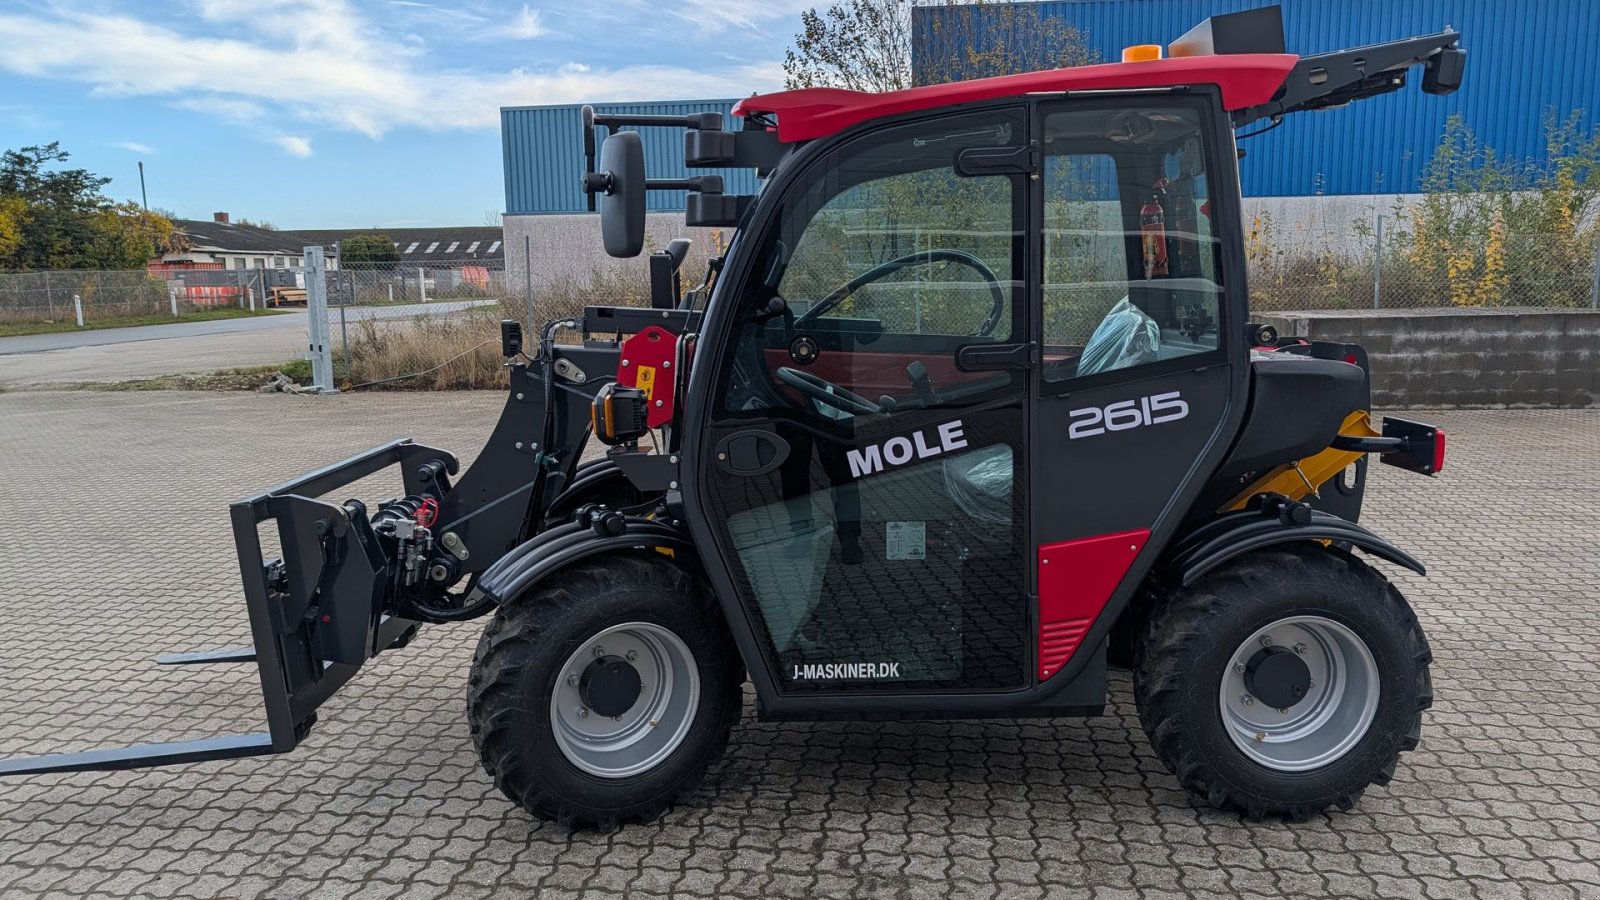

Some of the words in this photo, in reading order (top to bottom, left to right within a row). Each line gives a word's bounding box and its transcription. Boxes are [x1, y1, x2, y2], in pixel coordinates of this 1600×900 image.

[1068, 390, 1189, 440] 2615
[846, 419, 968, 478] MOLE
[793, 663, 900, 680] J-MASKINER.DK
